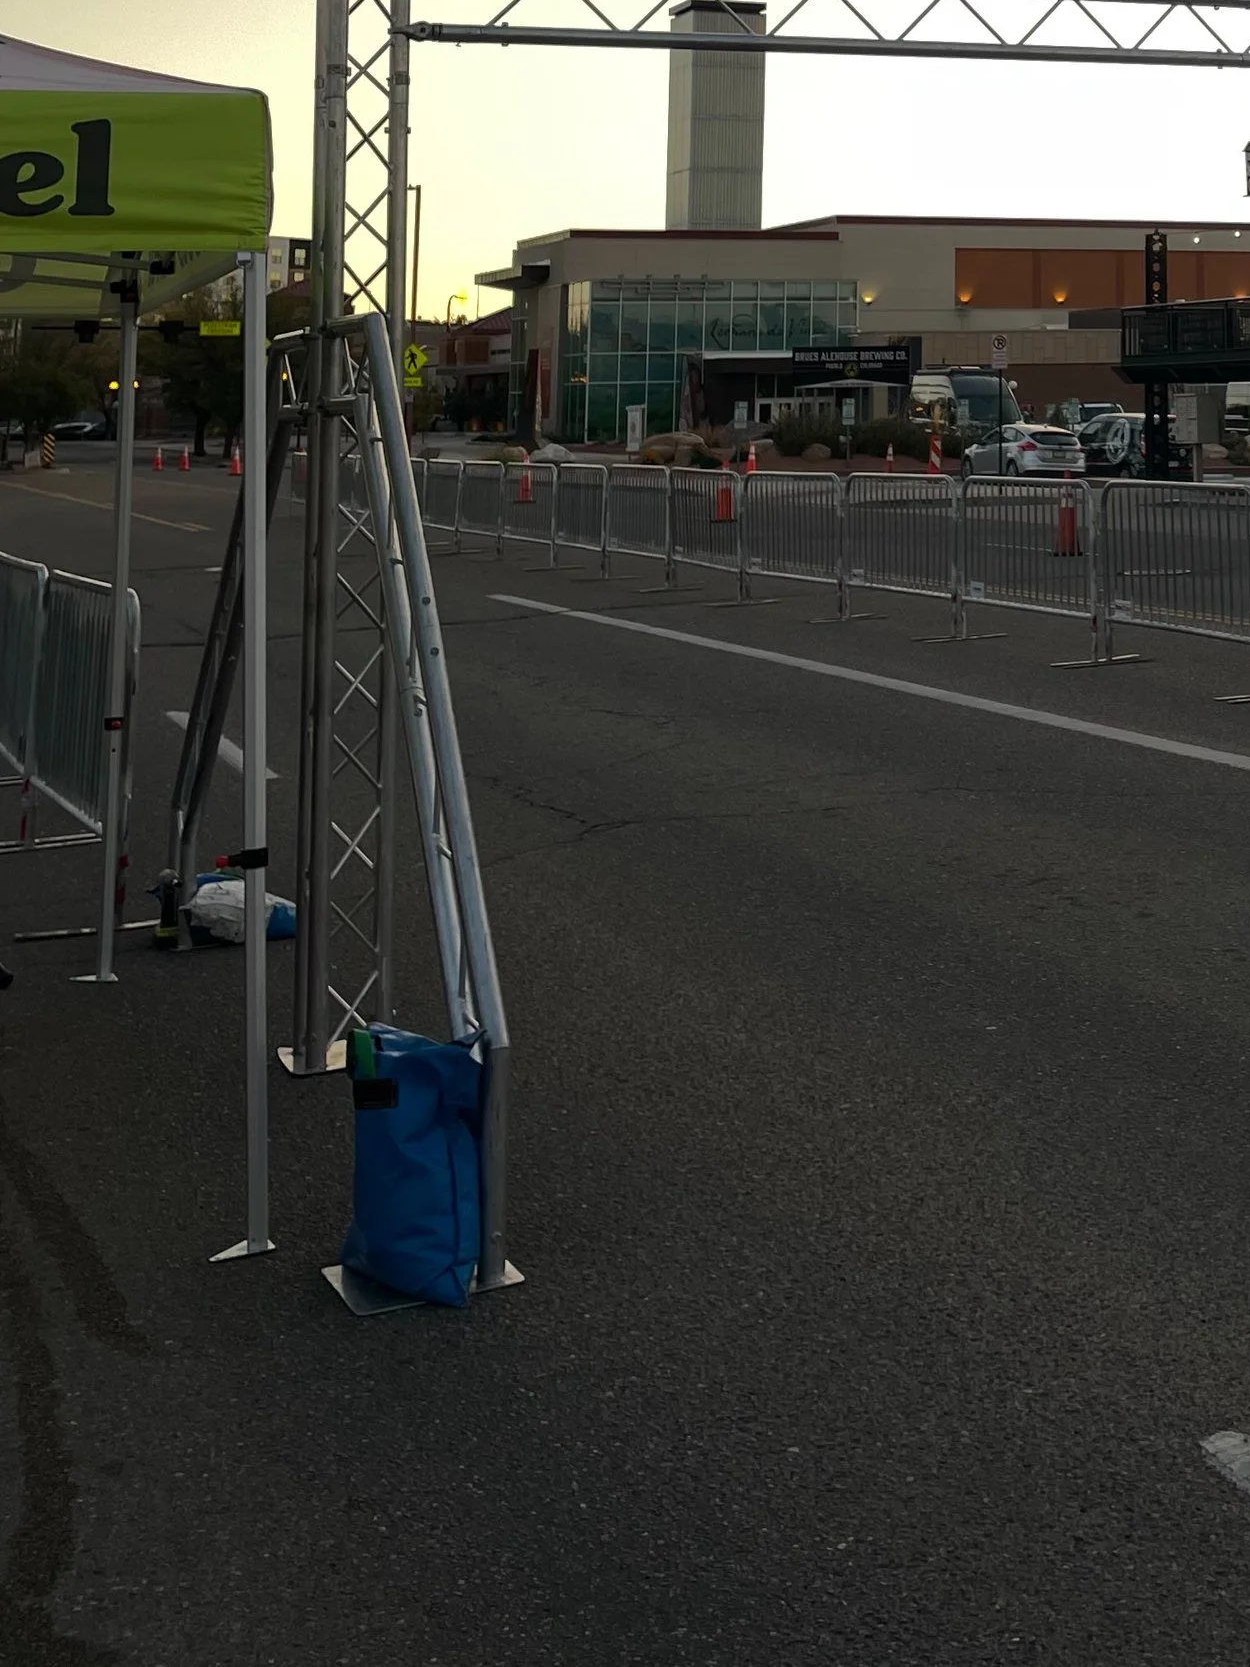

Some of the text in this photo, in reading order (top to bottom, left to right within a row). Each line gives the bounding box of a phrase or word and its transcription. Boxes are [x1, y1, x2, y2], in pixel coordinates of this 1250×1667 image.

[794, 351, 819, 362] BRUES
[820, 351, 859, 362] ALEHOUSE
[859, 350, 894, 361] BREWING
